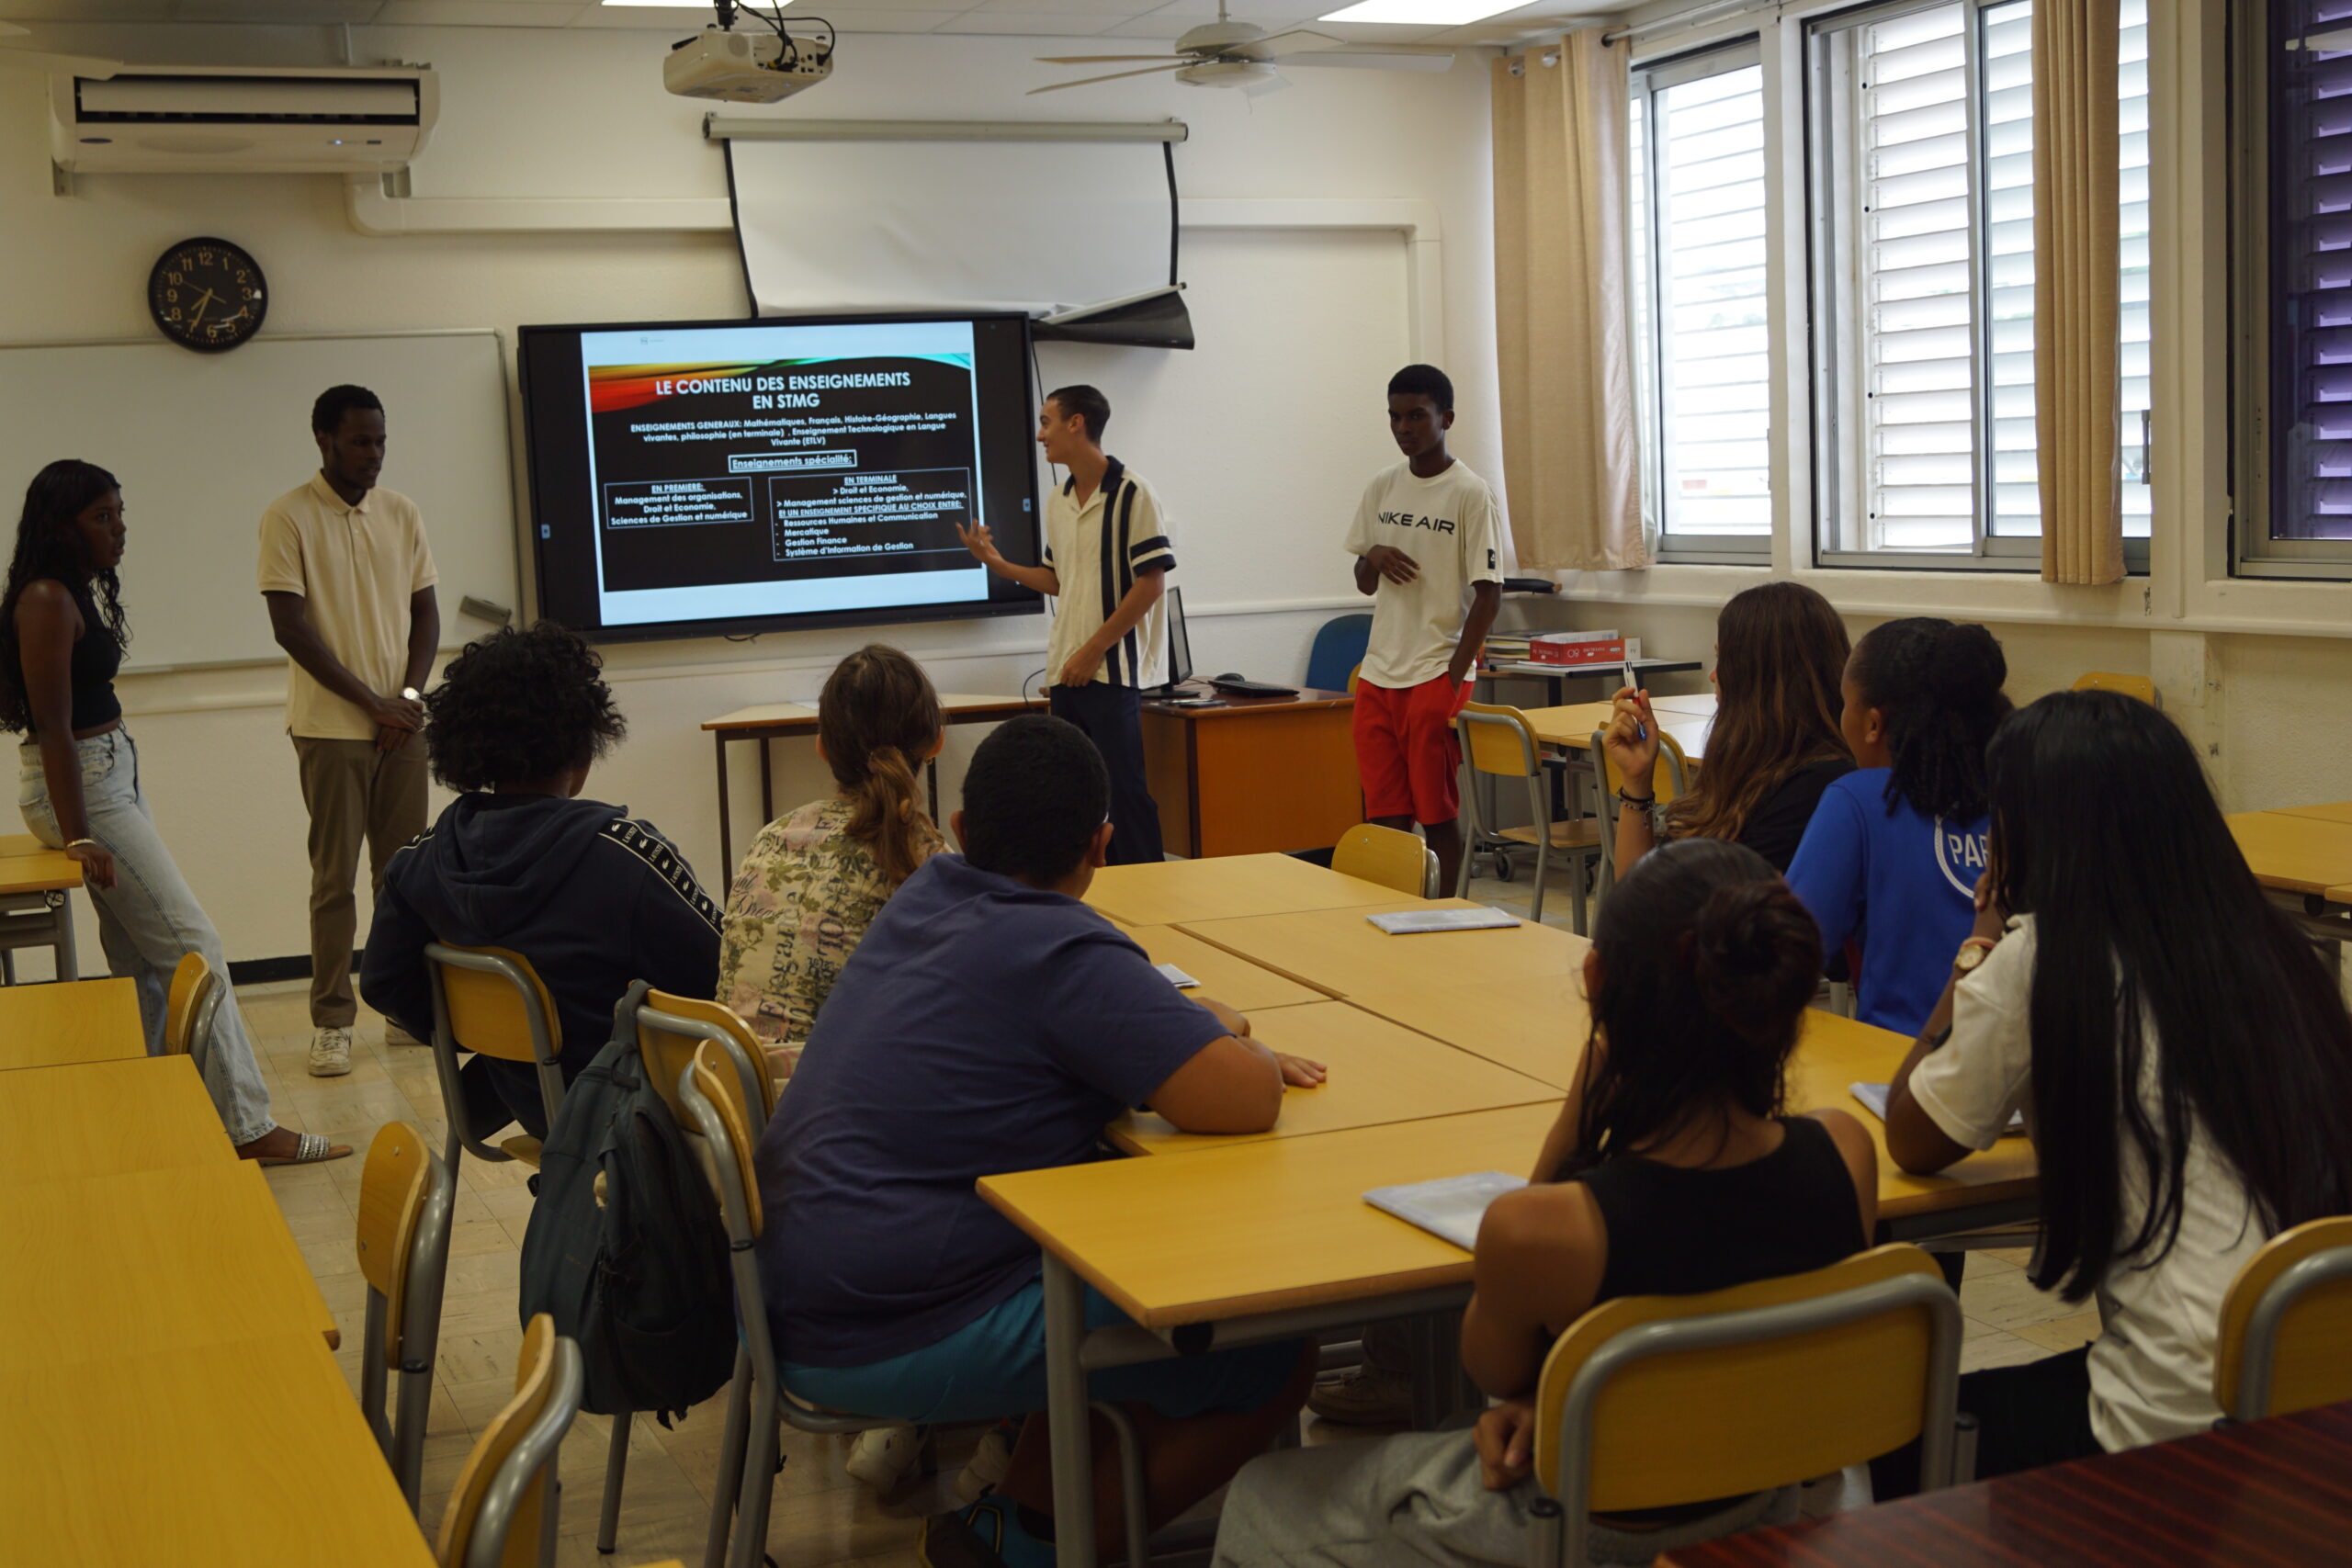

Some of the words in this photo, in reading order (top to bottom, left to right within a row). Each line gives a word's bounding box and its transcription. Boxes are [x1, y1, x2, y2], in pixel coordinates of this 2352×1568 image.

[182, 258, 193, 271] 11
[198, 252, 213, 265] 12
[222, 257, 229, 271] 1
[168, 272, 183, 286] 10
[236, 269, 246, 284] 2
[167, 288, 178, 302] 9
[242, 288, 252, 301] 3
[171, 307, 182, 321] 8
[239, 305, 249, 319] 4
[187, 319, 198, 333] 7
[207, 324, 217, 338] 6
[656, 380, 672, 395] LE
[676, 378, 752, 394] CONTENU
[757, 377, 785, 391] DES
[789, 372, 910, 389] ENSEIGNEMENTS
[752, 395, 773, 410] EN
[777, 393, 820, 409] STMG
[631, 422, 695, 433] ENSEIGNEMENTS
[696, 420, 742, 430] GENERAUX:
[924, 412, 956, 423] Langues
[643, 433, 680, 443] vivantes,
[681, 431, 727, 443] philosophie
[729, 430, 742, 440] (en
[743, 429, 785, 439] terminale)
[792, 426, 847, 437] Enseignement
[848, 423, 905, 434] Technologique
[917, 422, 947, 432] Langue
[771, 437, 801, 446] Vivante
[802, 436, 826, 446] (ETLV)
[732, 457, 804, 469] Enseignements
[805, 453, 853, 466] spécialité:
[844, 476, 855, 486] EN
[856, 474, 898, 484] TERMINALE
[651, 485, 663, 494] EN
[663, 483, 706, 493] PREMIERE:
[840, 486, 858, 495] Droit
[859, 486, 867, 494] et
[615, 494, 670, 505] Management
[672, 493, 686, 502] des
[783, 496, 837, 508] Management
[837, 495, 872, 504] sciences
[874, 494, 884, 502] de
[885, 493, 914, 504] gestion
[915, 492, 923, 501] et
[644, 505, 662, 513] Droit
[664, 504, 673, 513] et
[787, 508, 798, 517] UN
[800, 506, 853, 516] ENSEIGNEMENT
[854, 503, 897, 513] SPECIFIQUE
[899, 502, 910, 512] AU
[910, 502, 935, 511] CHOIX
[611, 516, 649, 525] Sciences
[650, 515, 661, 524] de
[662, 513, 694, 523] Gestion
[695, 513, 703, 521] et
[704, 511, 748, 522] numérique
[784, 517, 827, 527] Ressources
[828, 515, 866, 525] Humaines
[867, 514, 876, 523] et
[877, 512, 938, 523] Communication
[1379, 512, 1414, 526] NIKE
[1416, 516, 1455, 536] AIR
[785, 527, 830, 539] Mercatique
[785, 536, 815, 547] Gestion
[816, 536, 847, 546] Finance
[785, 546, 819, 558] Système
[872, 543, 883, 551] de
[884, 541, 914, 551] Gestion
